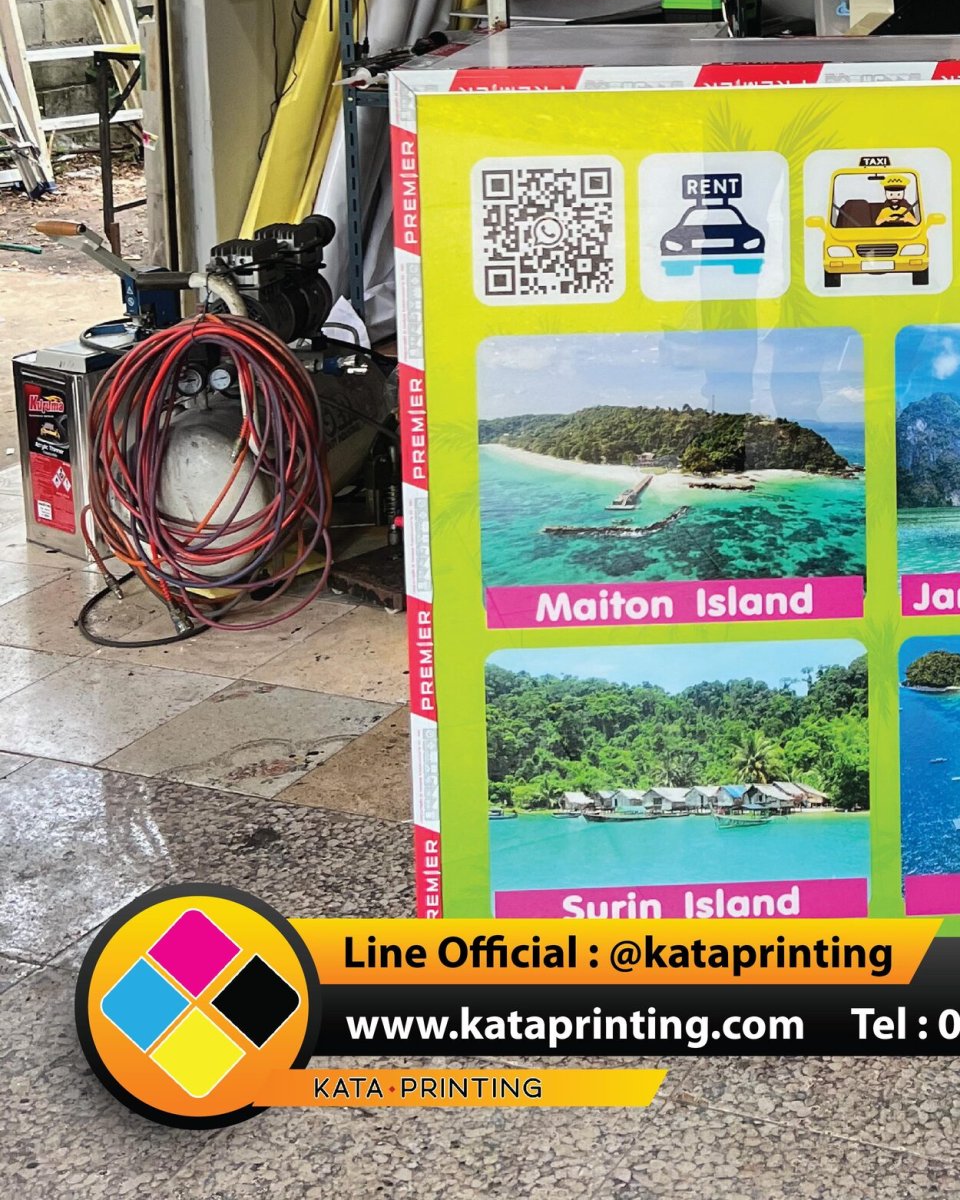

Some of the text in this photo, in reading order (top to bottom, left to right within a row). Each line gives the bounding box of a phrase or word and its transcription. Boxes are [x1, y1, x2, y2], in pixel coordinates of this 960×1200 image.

[687, 177, 739, 196] RENT
[863, 157, 888, 166] TAXI
[400, 139, 419, 245] PREMIER
[406, 377, 427, 481] PREMIER
[536, 583, 814, 622] Maiton Island
[418, 610, 435, 711] PREMIER
[423, 838, 441, 918] REMIER
[562, 885, 800, 919] Surin Island
